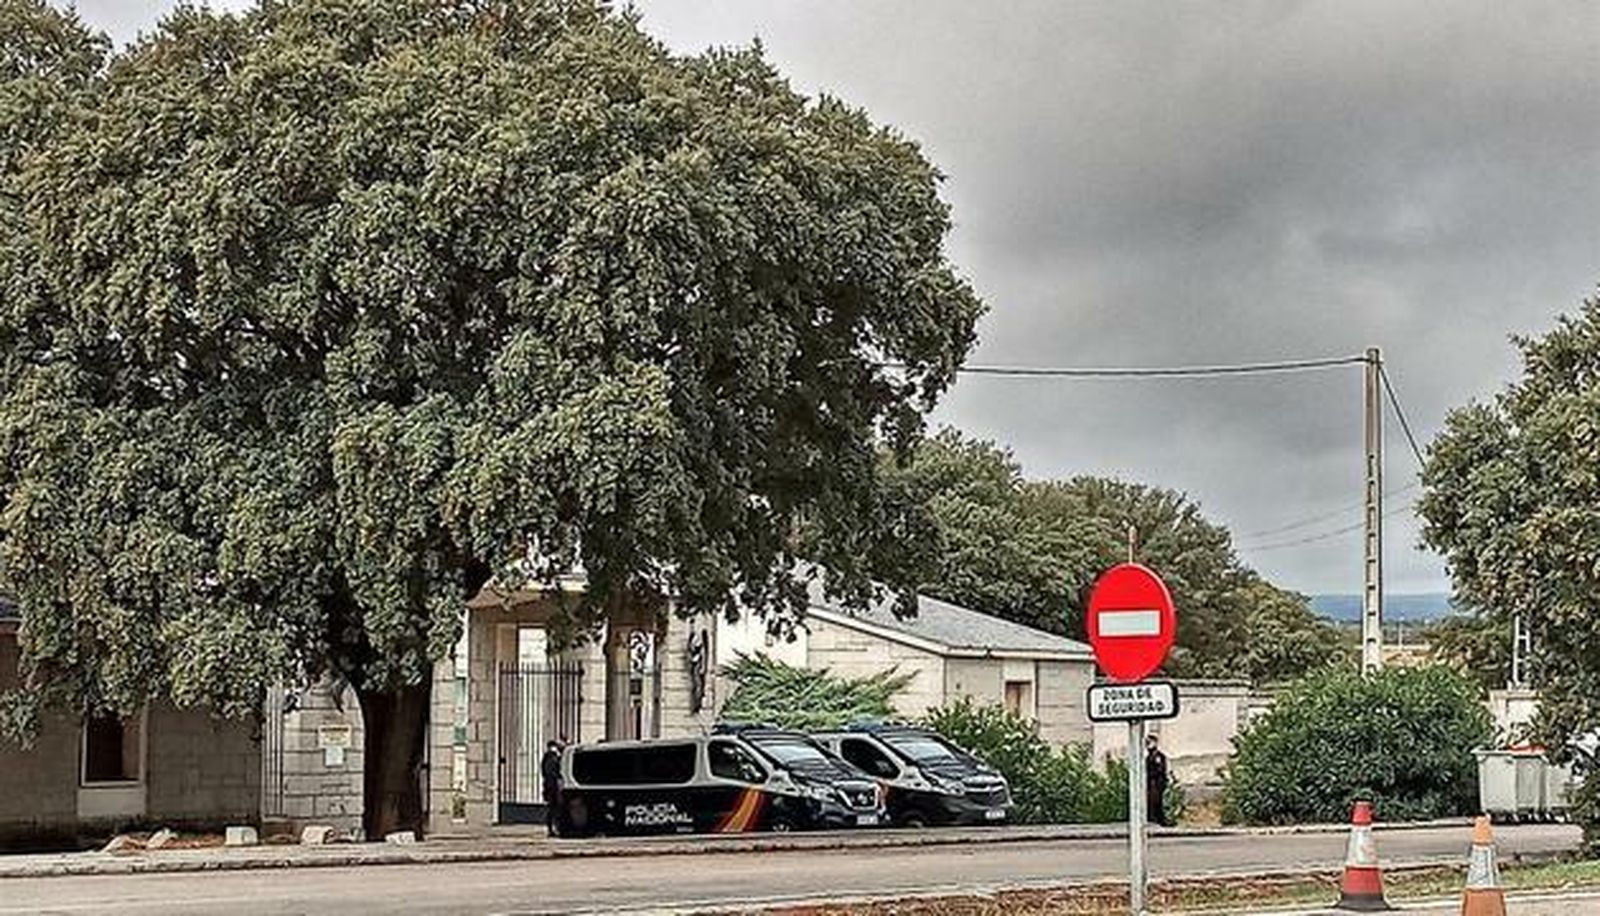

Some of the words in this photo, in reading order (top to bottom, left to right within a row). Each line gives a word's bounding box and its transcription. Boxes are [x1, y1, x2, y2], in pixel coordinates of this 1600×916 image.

[1104, 688, 1134, 701] ZONA
[1136, 687, 1152, 699] DE
[1098, 700, 1165, 715] SEGURIDAD
[625, 813, 693, 826] NACIONAL
